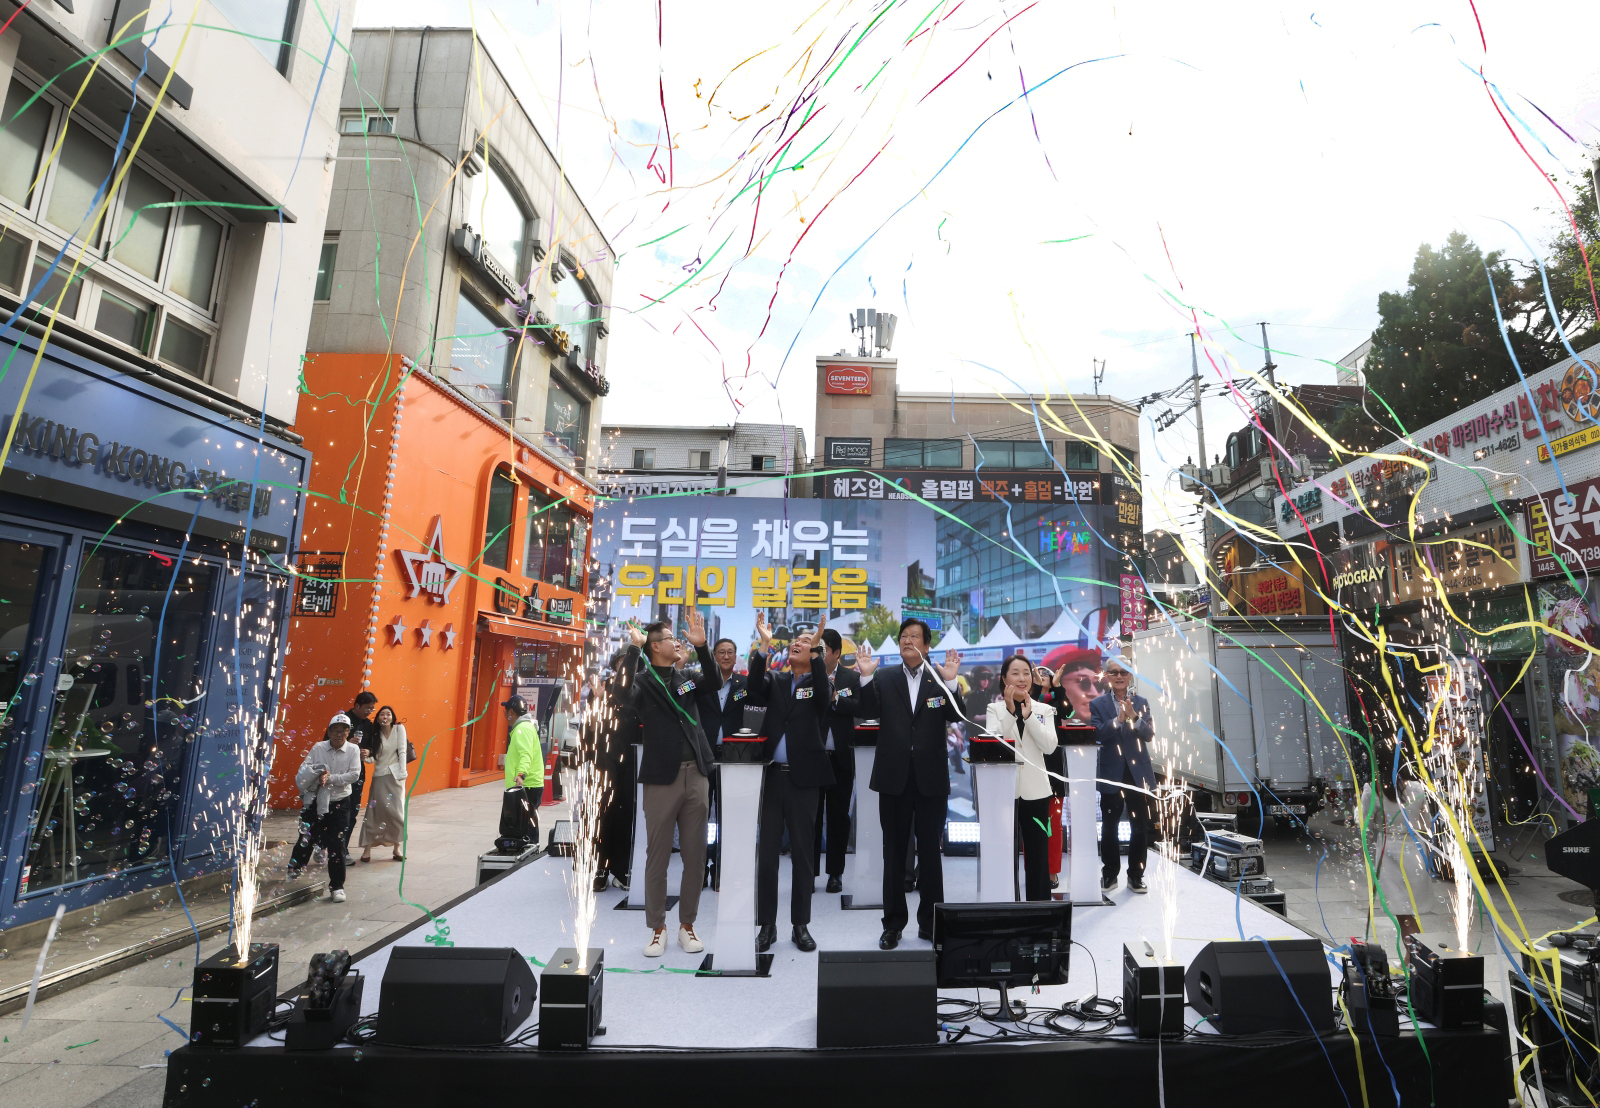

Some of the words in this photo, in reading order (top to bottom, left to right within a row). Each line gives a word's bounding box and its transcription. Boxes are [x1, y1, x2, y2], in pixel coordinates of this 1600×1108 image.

[1517, 379, 1561, 439] 반찬
[1451, 401, 1516, 447] 파티마수선
[15, 412, 100, 466] KING
[106, 441, 187, 490] KONG
[833, 477, 884, 499] 헤즈업
[921, 480, 974, 500] 홀덤펍
[1118, 501, 1140, 525] 만원!
[230, 531, 257, 545] vapng
[619, 517, 739, 559] 도심을
[751, 519, 869, 561] 채우는
[1333, 565, 1385, 590] PHOTOGRAY
[1537, 562, 1556, 573] 144호
[303, 578, 333, 594] 전자
[616, 564, 737, 608] 우리의
[751, 567, 869, 609] 발걸음
[302, 594, 331, 611] 담배
